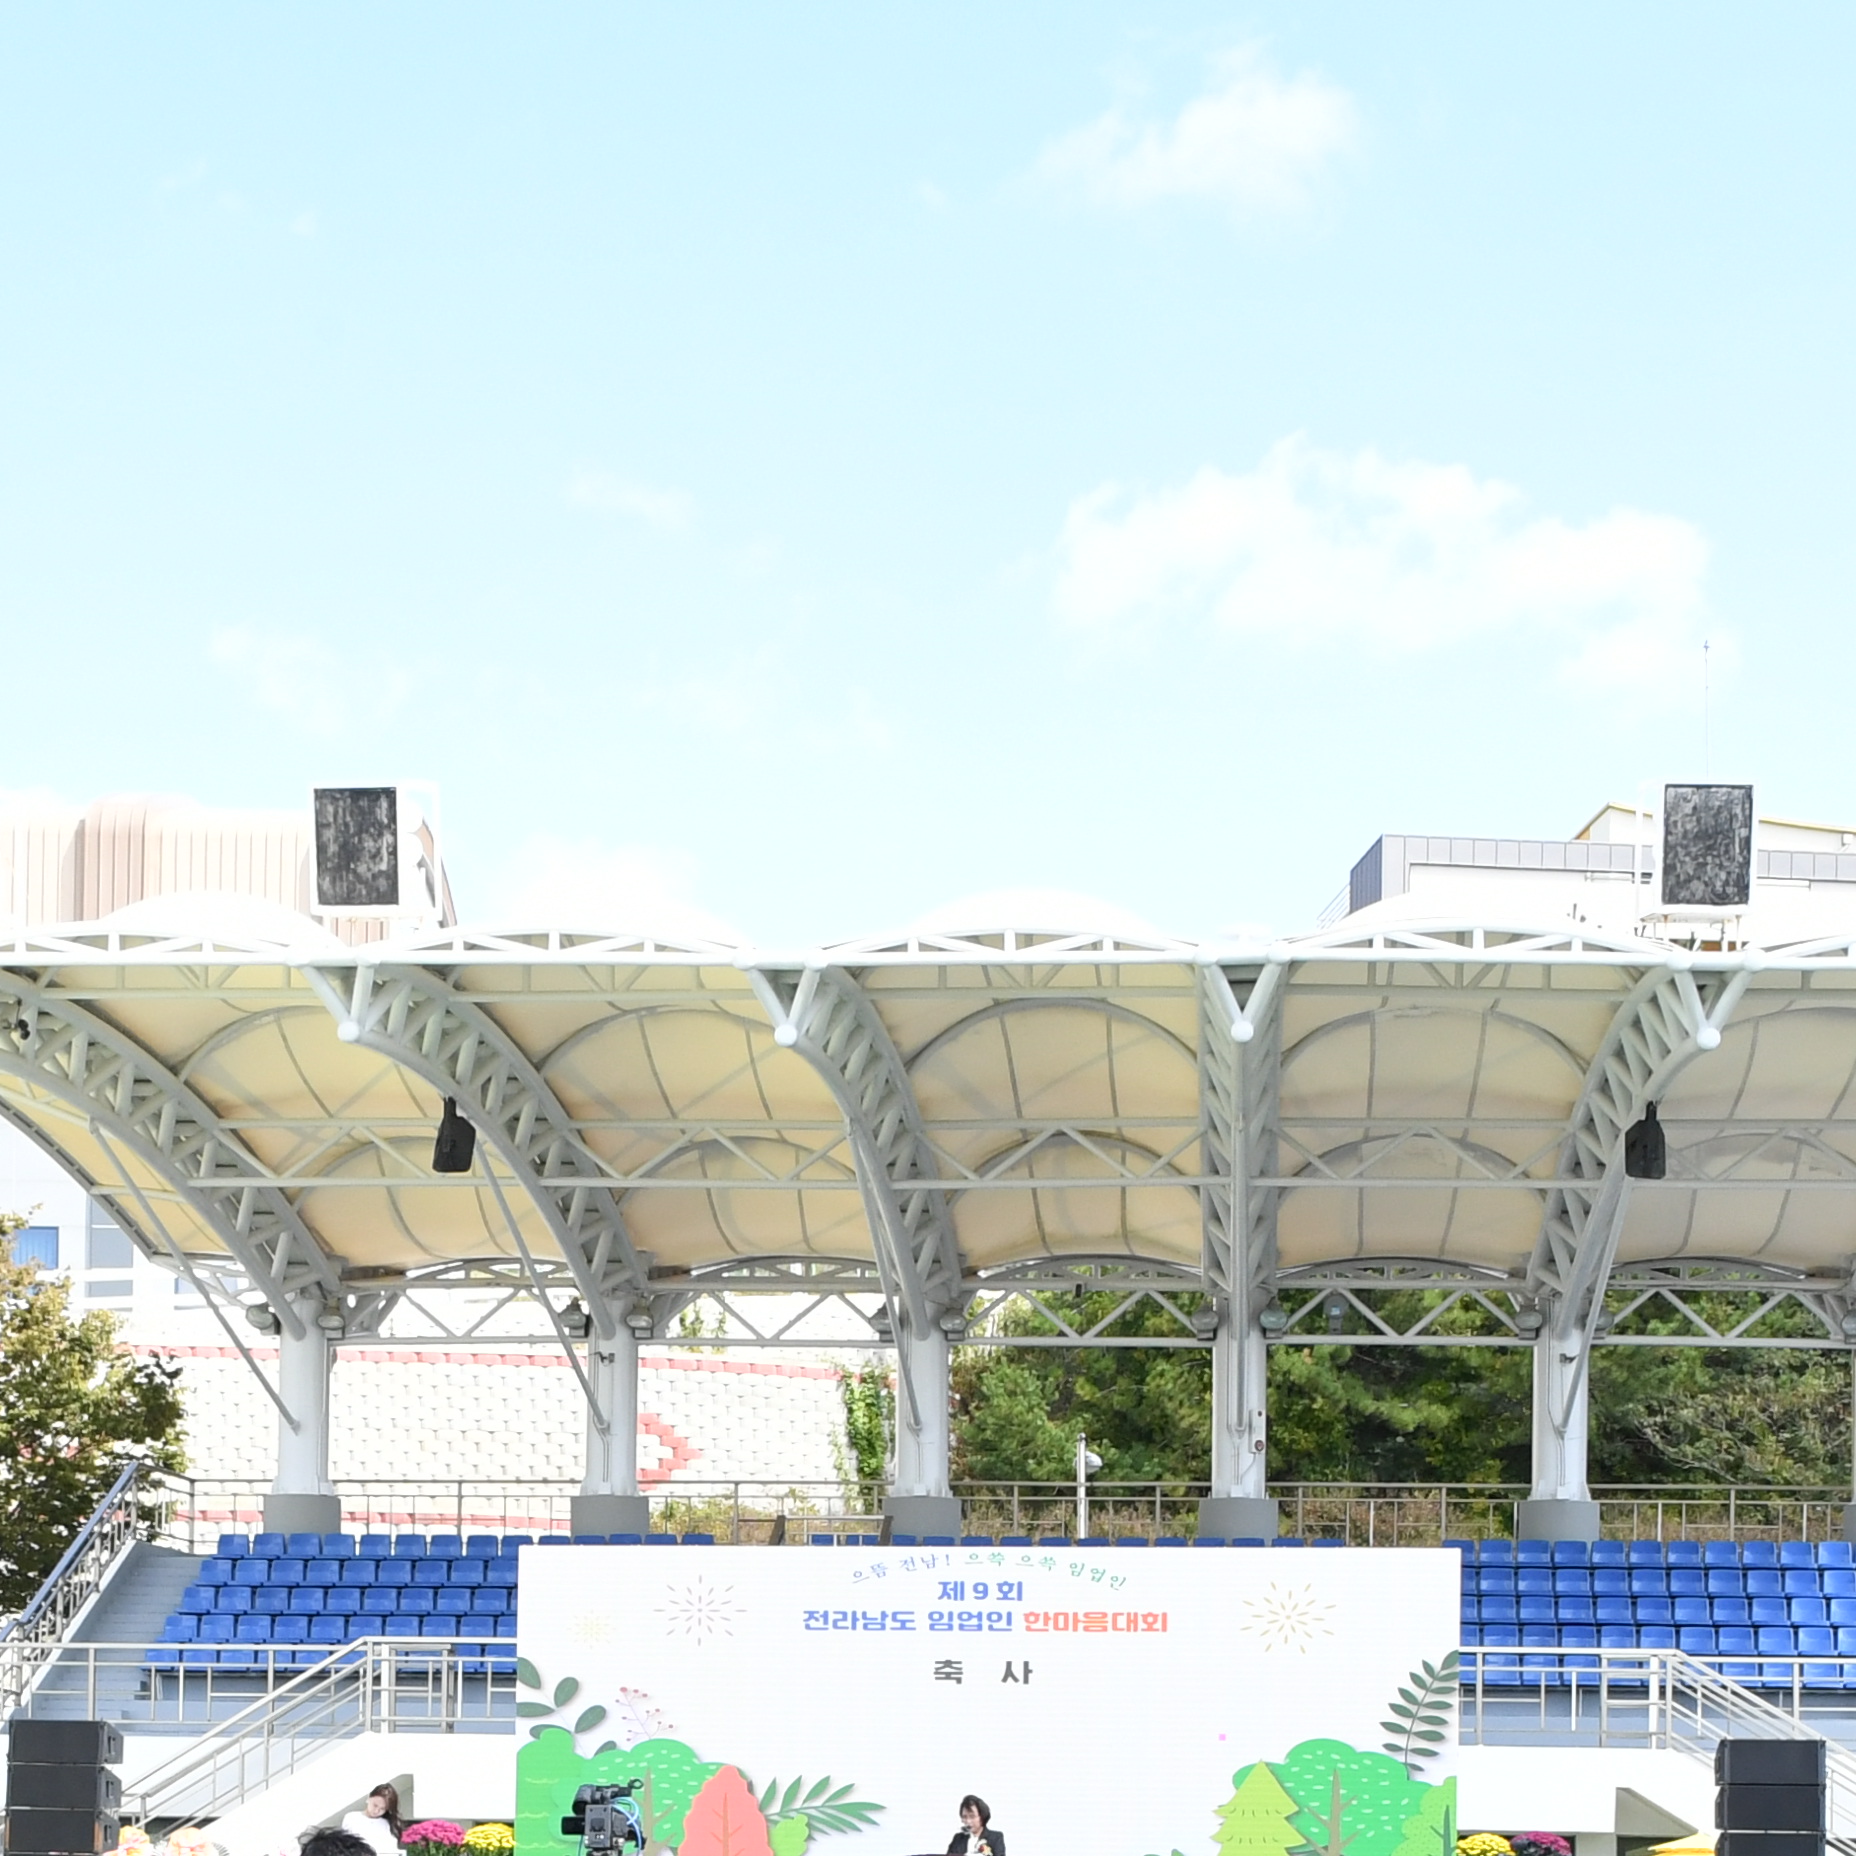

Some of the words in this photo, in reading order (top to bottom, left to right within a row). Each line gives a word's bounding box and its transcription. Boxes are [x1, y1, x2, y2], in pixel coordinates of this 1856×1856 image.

[851, 1562, 889, 1584] 으뜸
[899, 1553, 951, 1572] 전남!
[964, 1551, 1005, 1567] 으쓱
[1015, 1553, 1058, 1572] 으쓱
[1069, 1561, 1127, 1592] 임업인
[803, 1610, 917, 1632] 전라남도
[927, 1610, 1013, 1632] 임업인
[1023, 1611, 1168, 1633] 한마음대회
